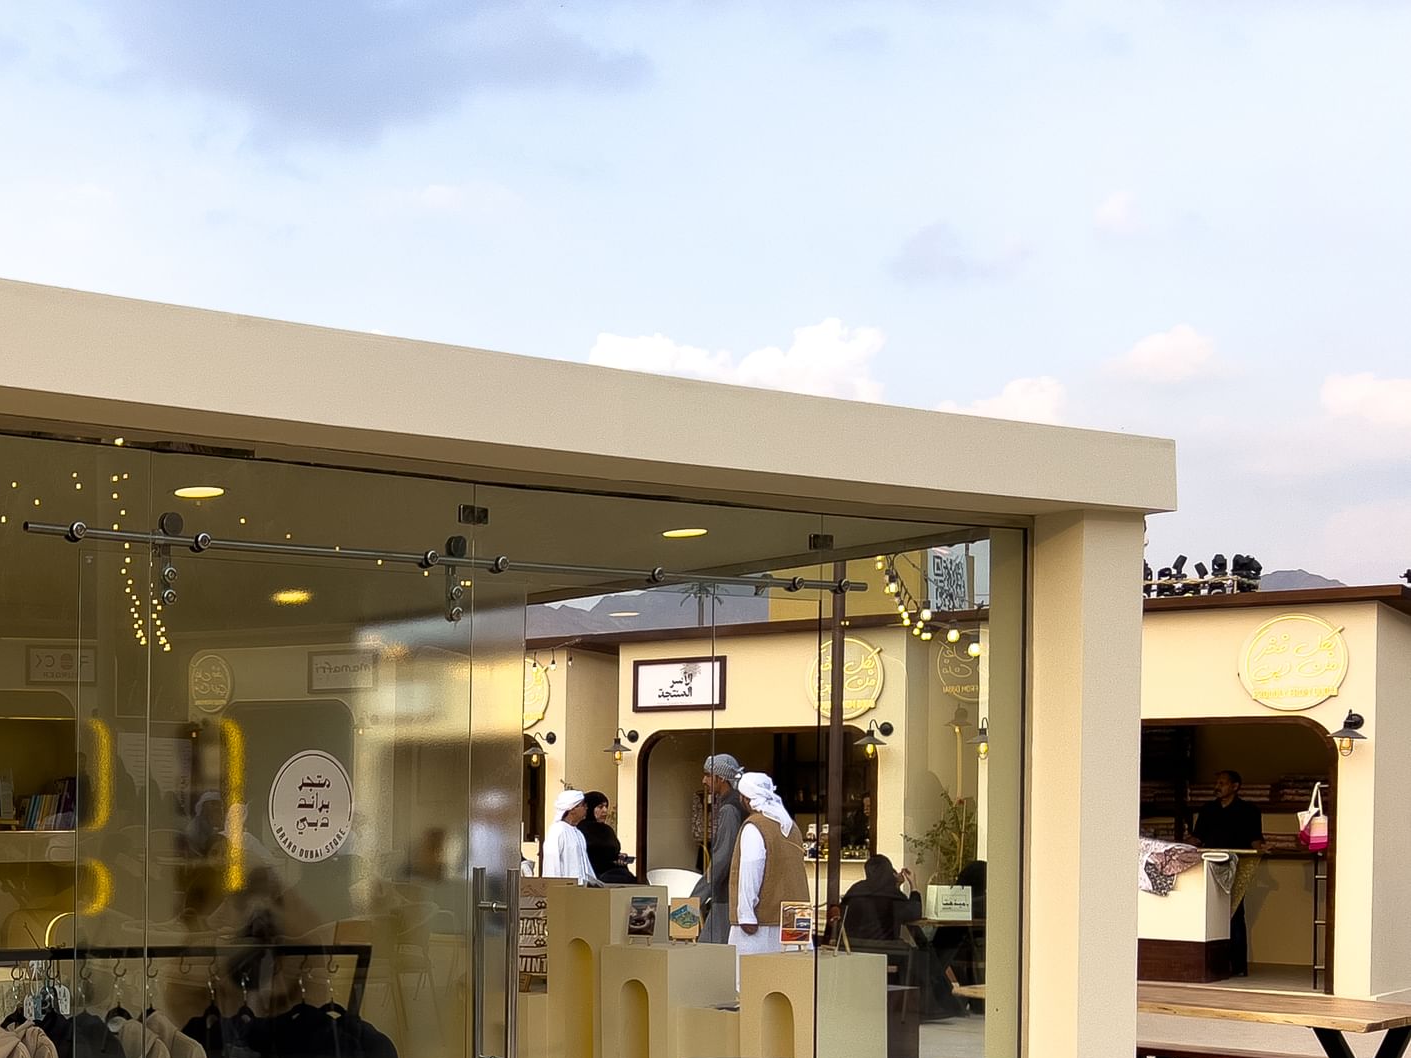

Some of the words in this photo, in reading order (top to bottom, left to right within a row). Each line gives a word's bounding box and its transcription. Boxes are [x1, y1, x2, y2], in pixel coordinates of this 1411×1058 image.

[298, 775, 331, 792] متجر
[297, 792, 330, 813] براند
[296, 816, 329, 835] دبي
[276, 827, 297, 853] BRAND
[299, 847, 322, 859] DUBAI
[325, 828, 346, 853] STORE
